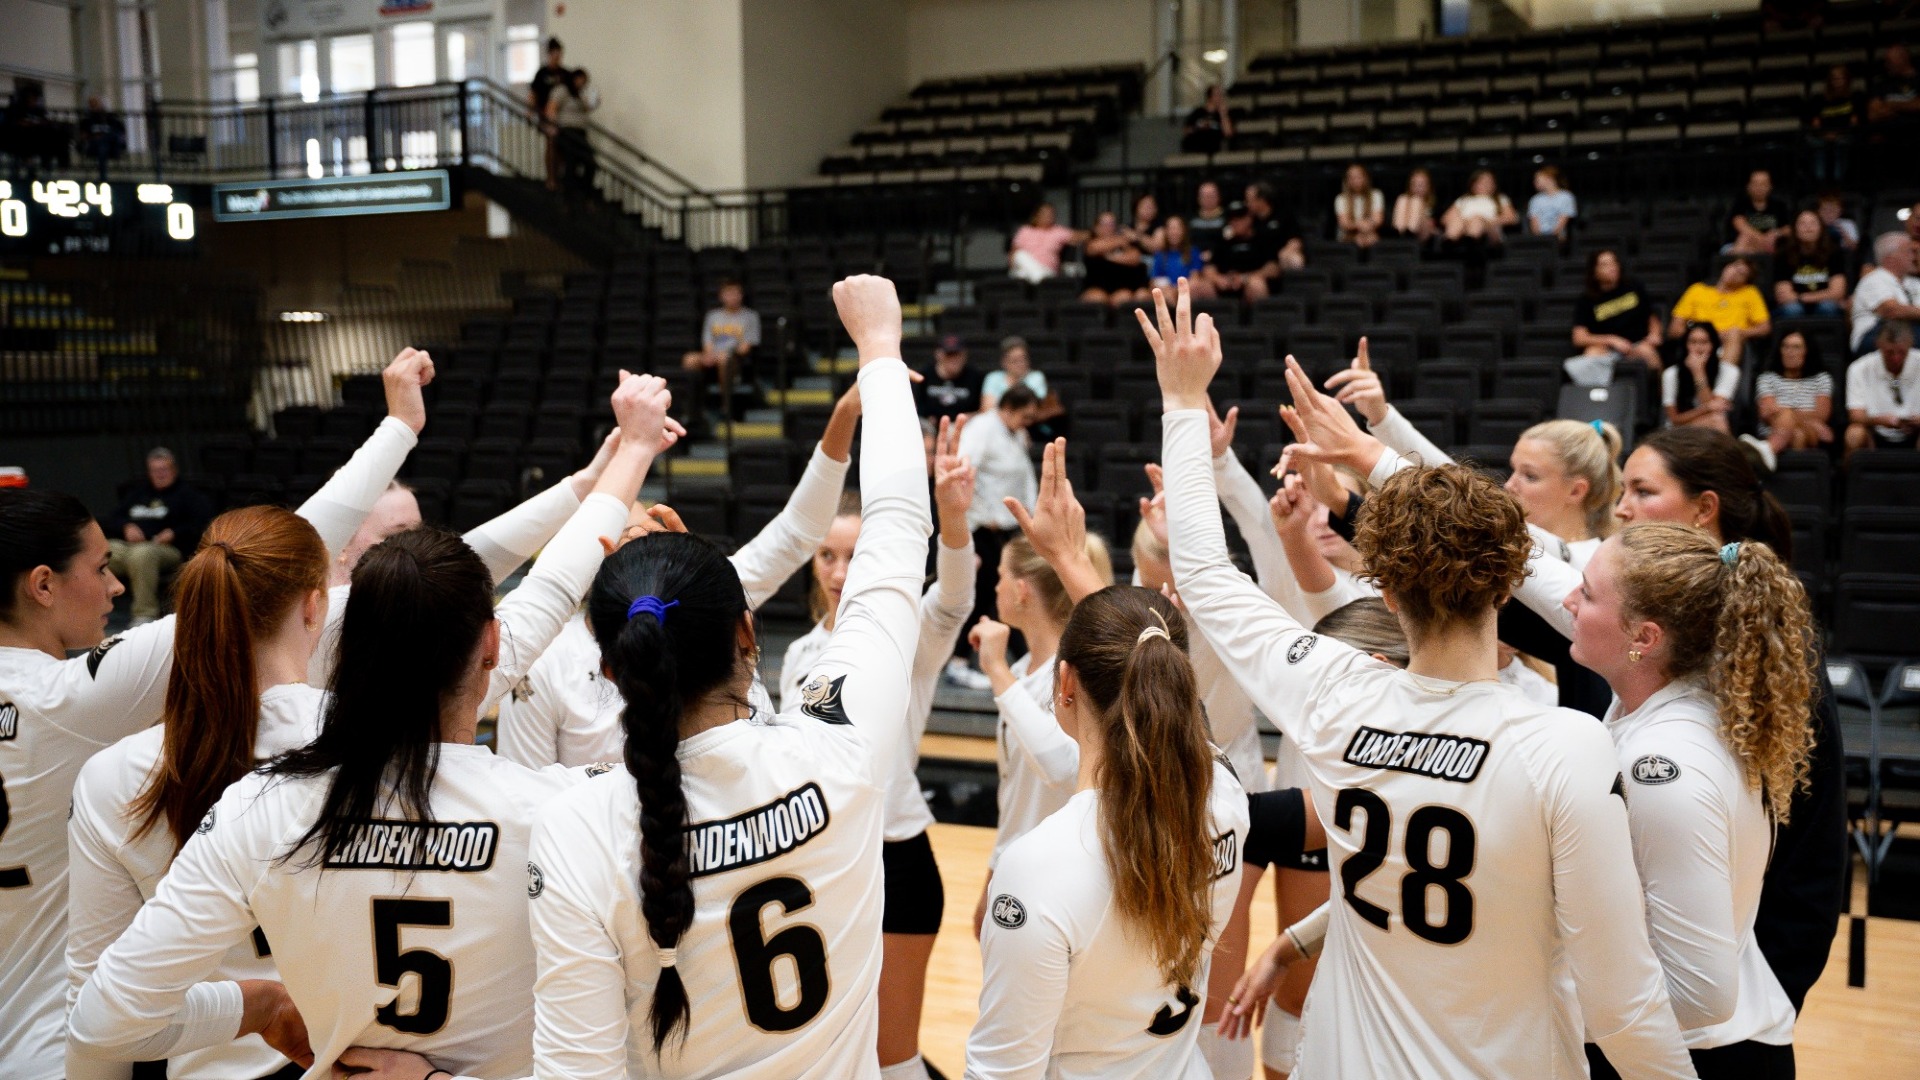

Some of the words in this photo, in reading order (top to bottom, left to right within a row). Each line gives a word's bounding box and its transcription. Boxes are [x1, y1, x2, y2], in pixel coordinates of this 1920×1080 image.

[32, 180, 113, 217] 42.4
[167, 203, 195, 240] 0
[1347, 729, 1486, 779] LINDENWOOD
[683, 787, 825, 873] NDENWOOD
[1334, 787, 1478, 947] 28
[370, 895, 455, 1037] 5
[726, 873, 832, 1034] 6
